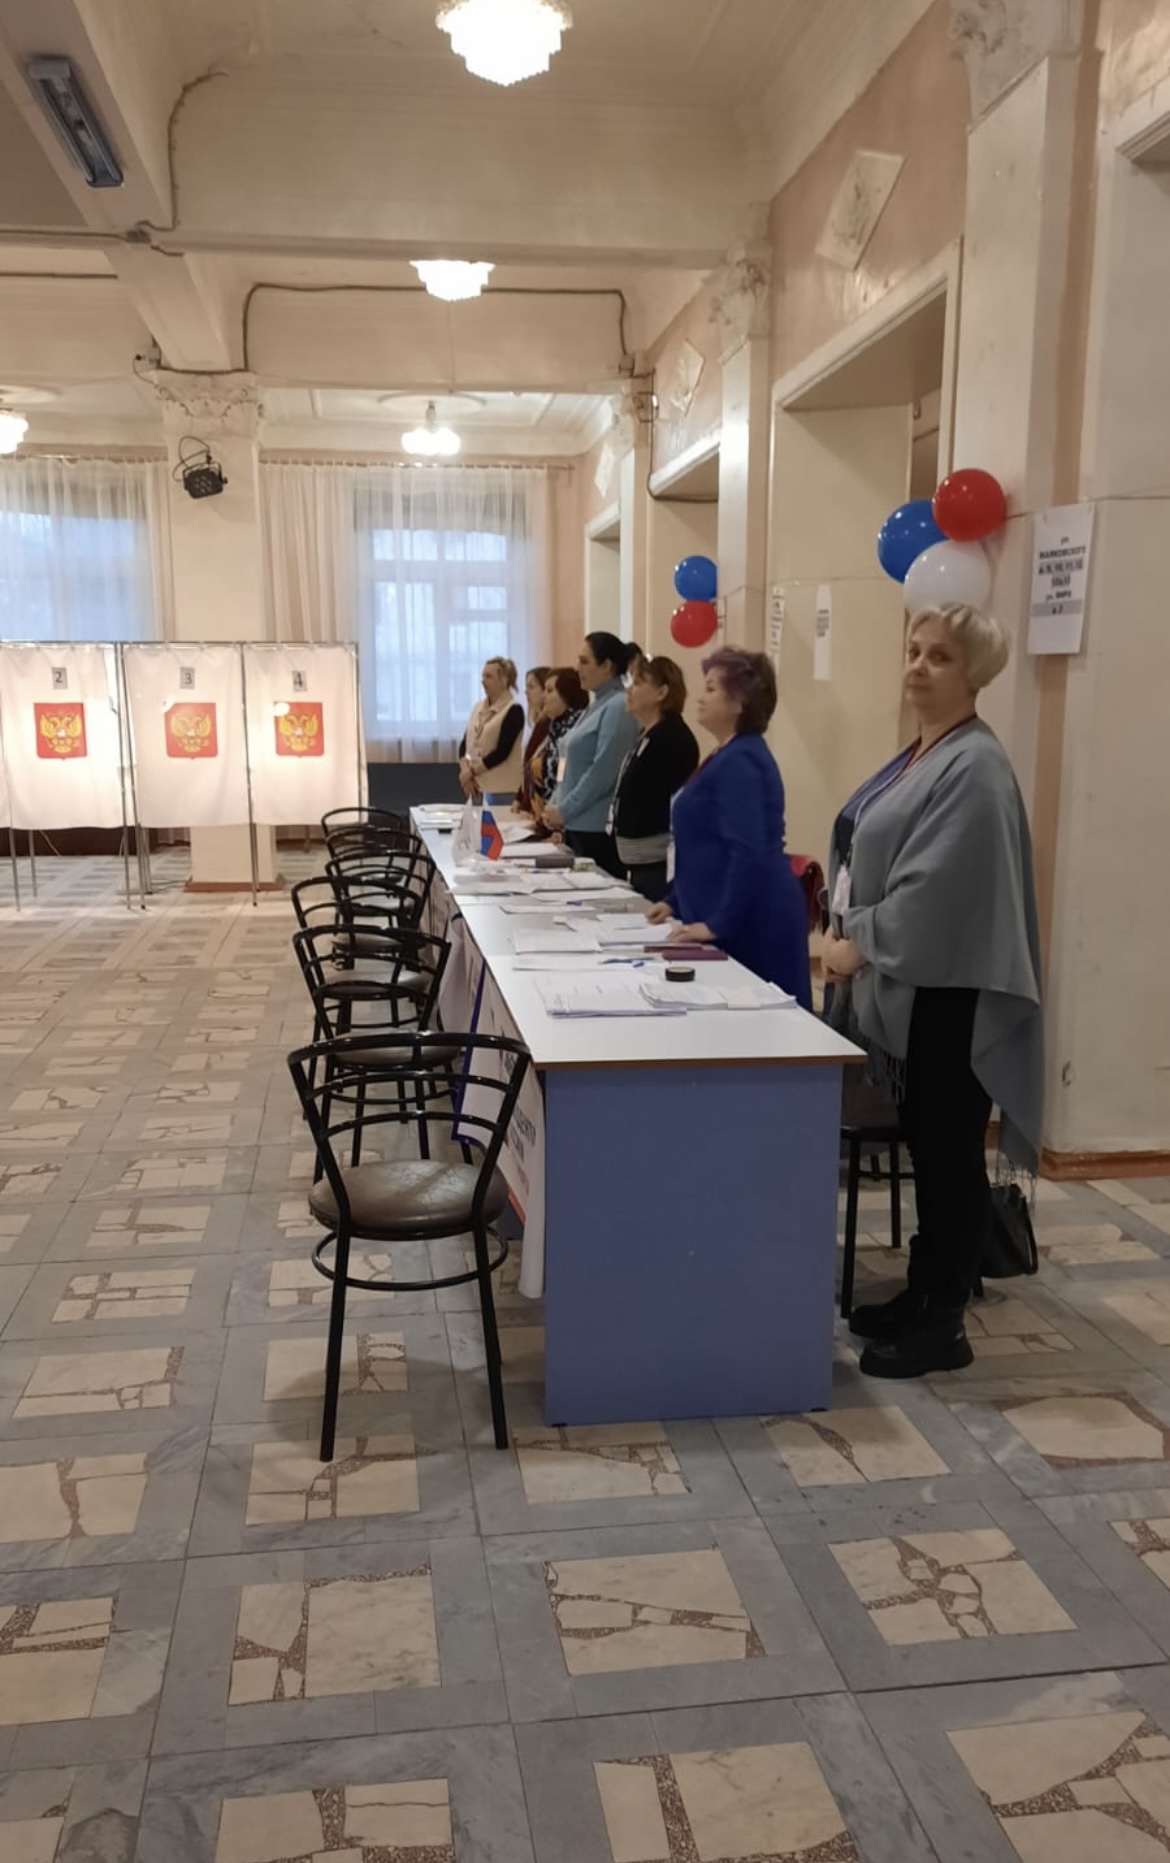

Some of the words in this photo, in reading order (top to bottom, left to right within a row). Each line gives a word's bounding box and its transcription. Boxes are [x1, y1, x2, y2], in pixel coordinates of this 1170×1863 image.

[55, 671, 63, 683] 2
[185, 672, 192, 685] 3
[293, 672, 303, 688] 4
